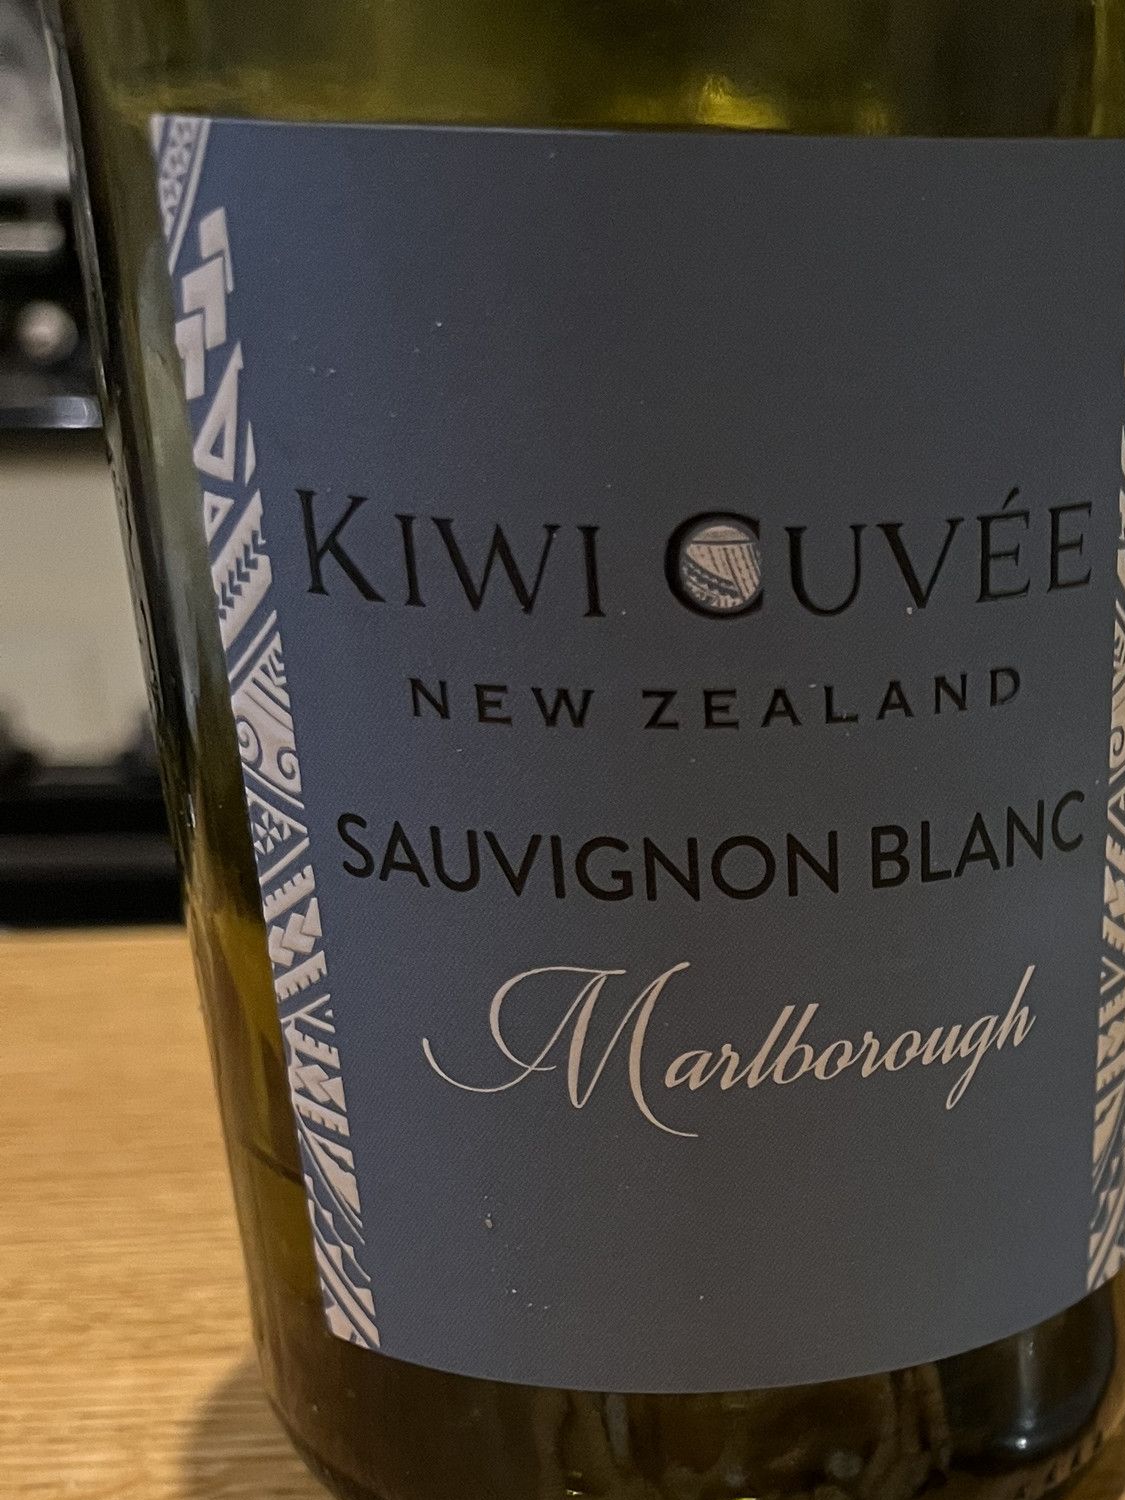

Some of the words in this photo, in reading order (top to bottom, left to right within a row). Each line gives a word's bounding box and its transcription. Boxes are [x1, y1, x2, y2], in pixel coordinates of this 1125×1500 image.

[295, 489, 606, 618] KIWI
[664, 486, 1094, 620] CUVÉE
[408, 677, 595, 729] NEW
[642, 667, 1022, 730] ZEALAND
[336, 812, 840, 902] SAUVIGNON
[872, 790, 1085, 889] BLANC
[422, 961, 1035, 1137] Marlborough
